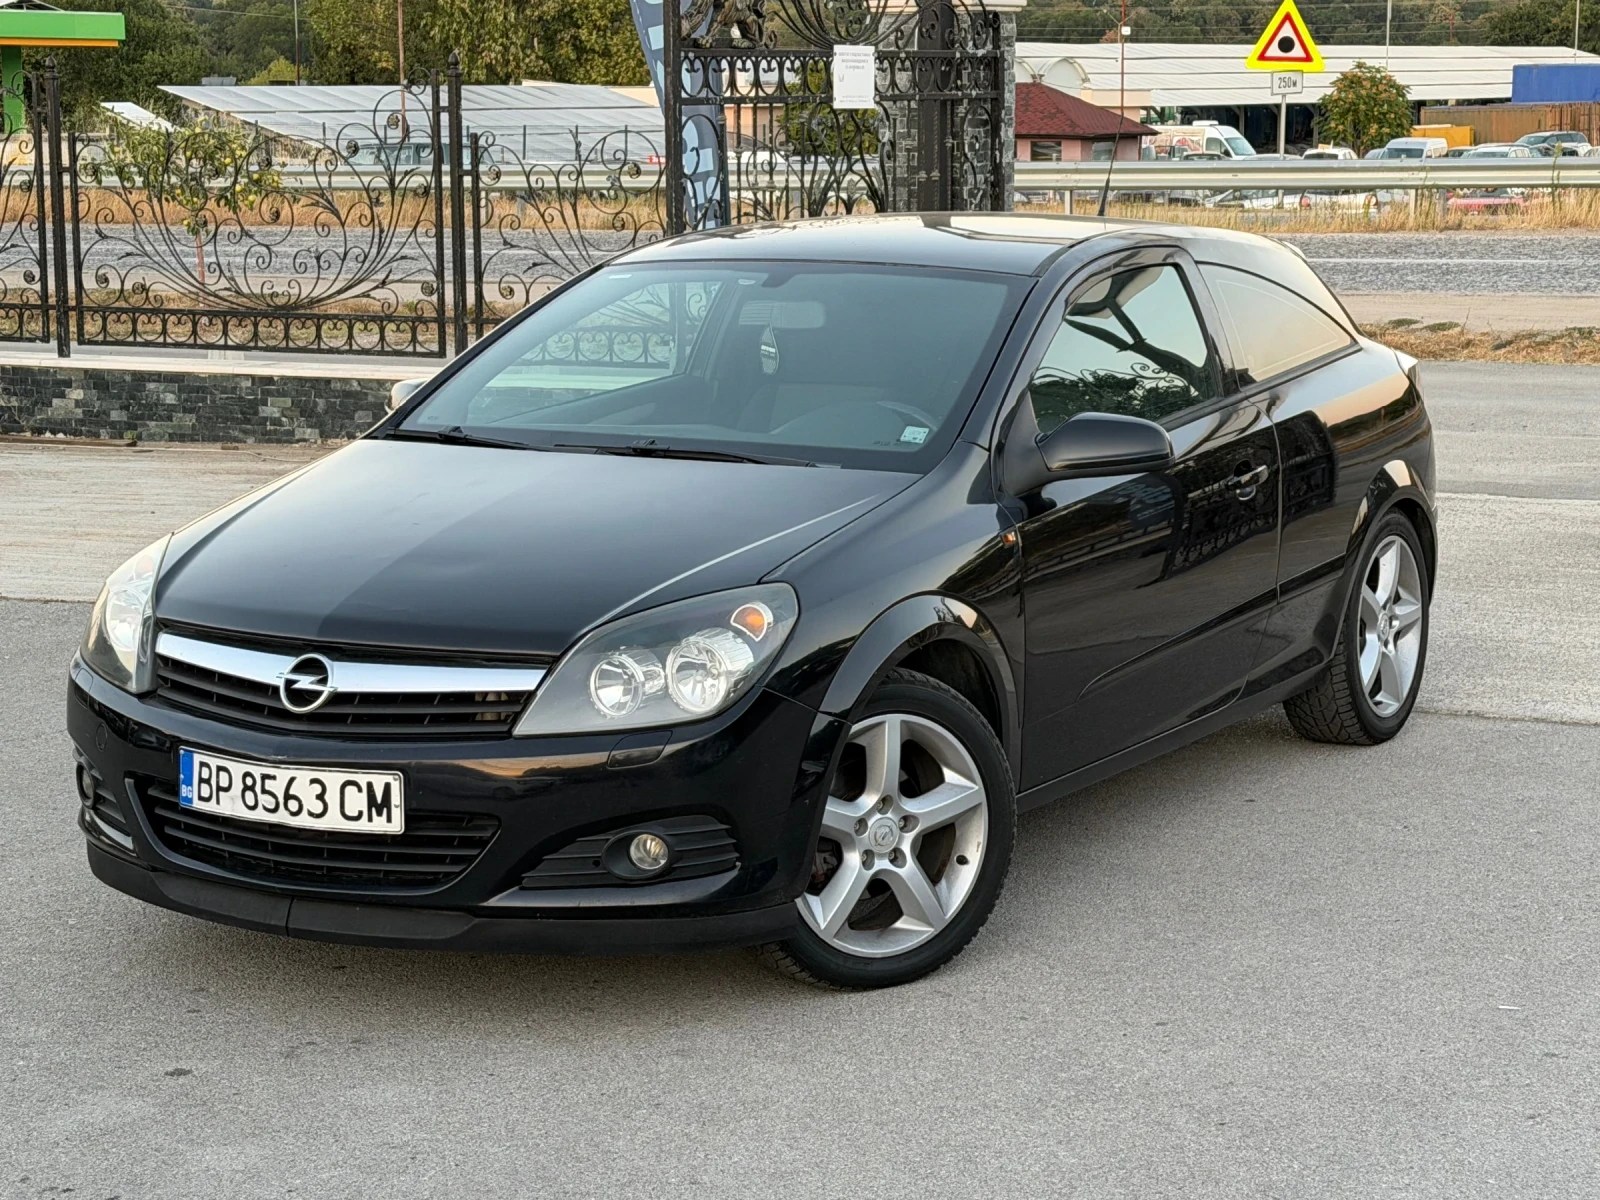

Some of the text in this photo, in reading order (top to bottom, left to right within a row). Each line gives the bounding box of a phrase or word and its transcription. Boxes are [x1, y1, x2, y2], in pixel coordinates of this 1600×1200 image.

[181, 784, 193, 798] BG
[197, 760, 393, 824] BP 8563 CM
